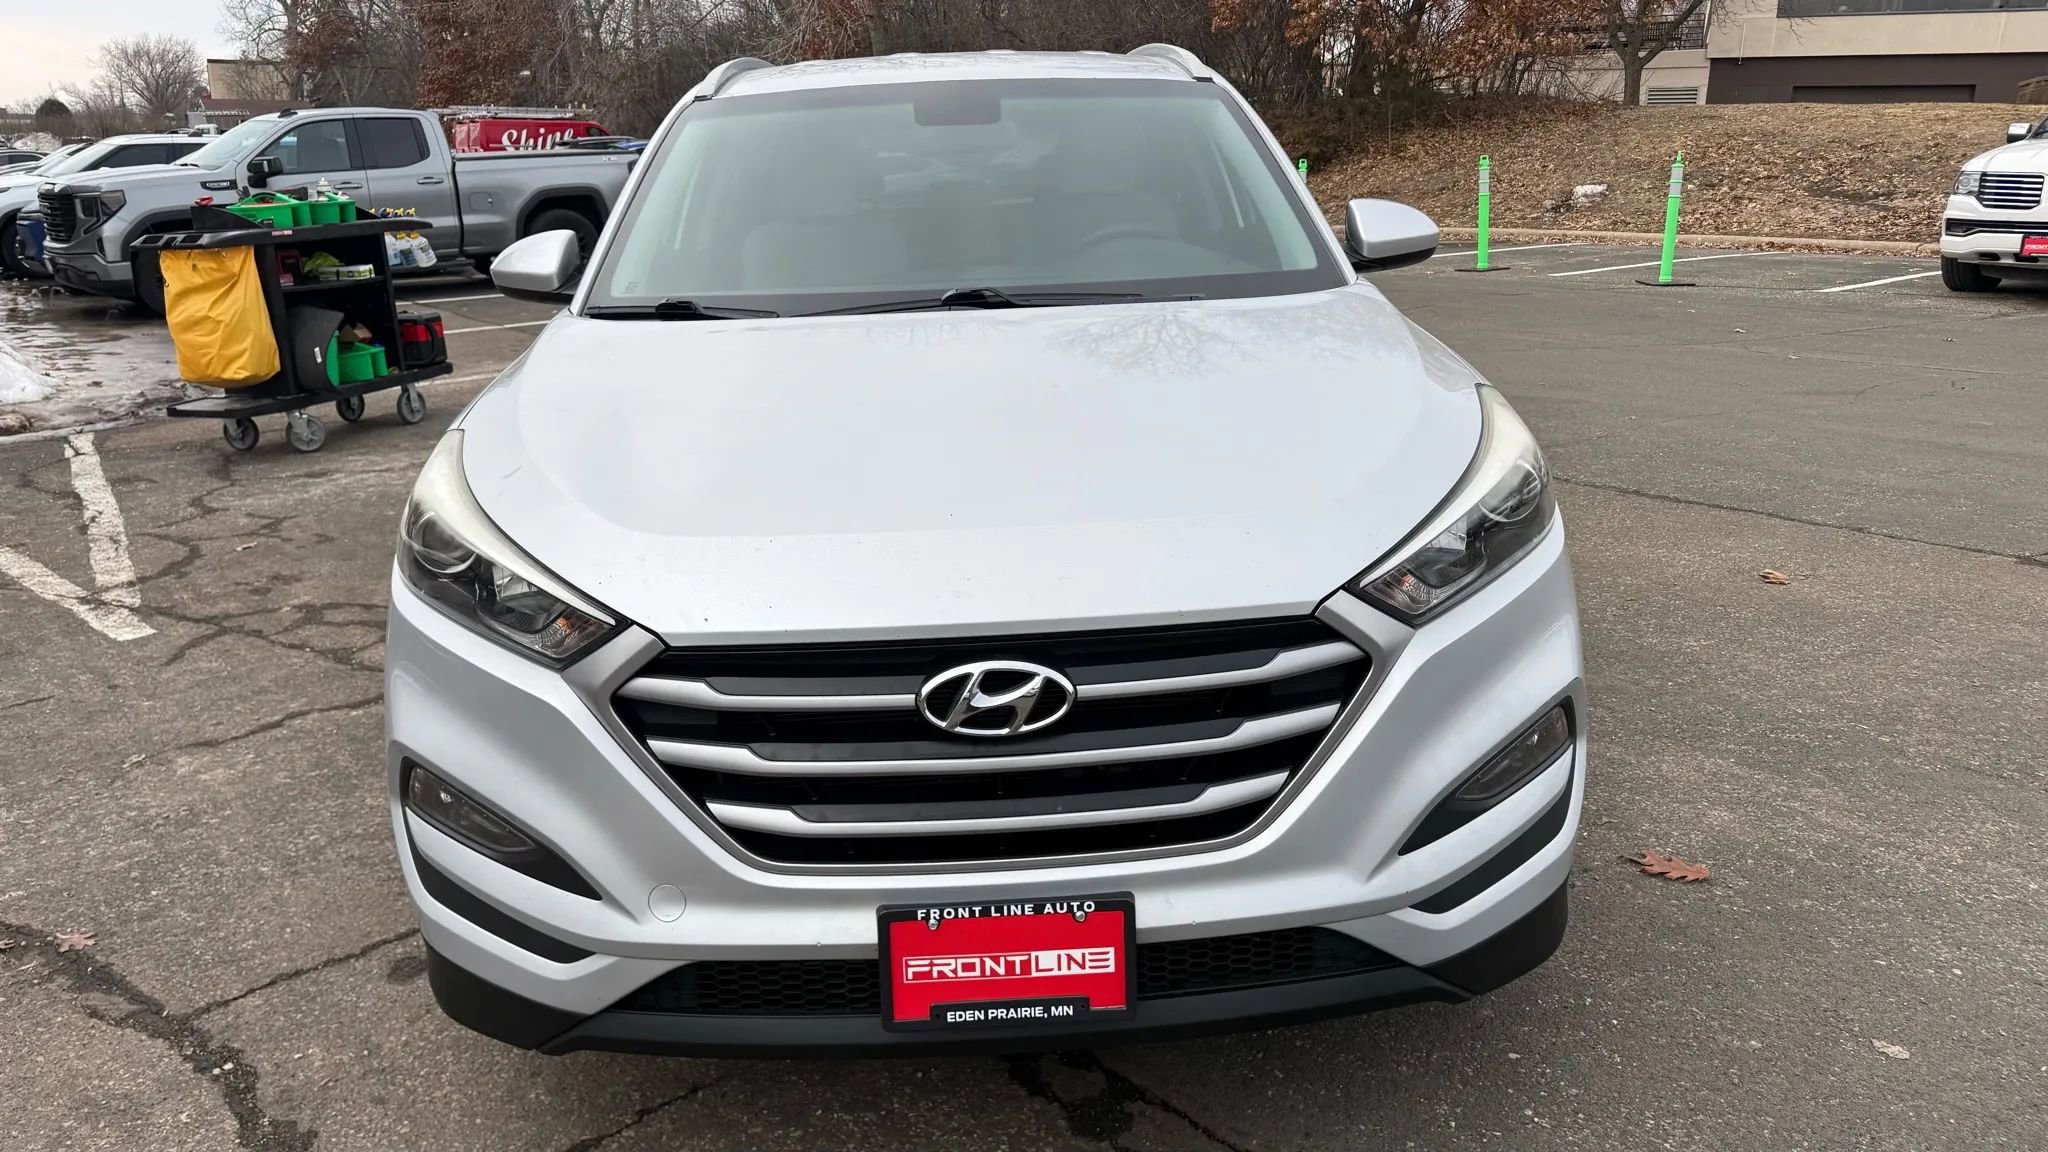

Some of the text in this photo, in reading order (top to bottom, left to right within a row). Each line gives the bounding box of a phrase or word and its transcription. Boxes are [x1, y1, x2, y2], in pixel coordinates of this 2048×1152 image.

[917, 901, 1095, 920] FRONT LINE AUTO
[946, 1005, 1074, 1022] EDEN PRAIRIE, MN
